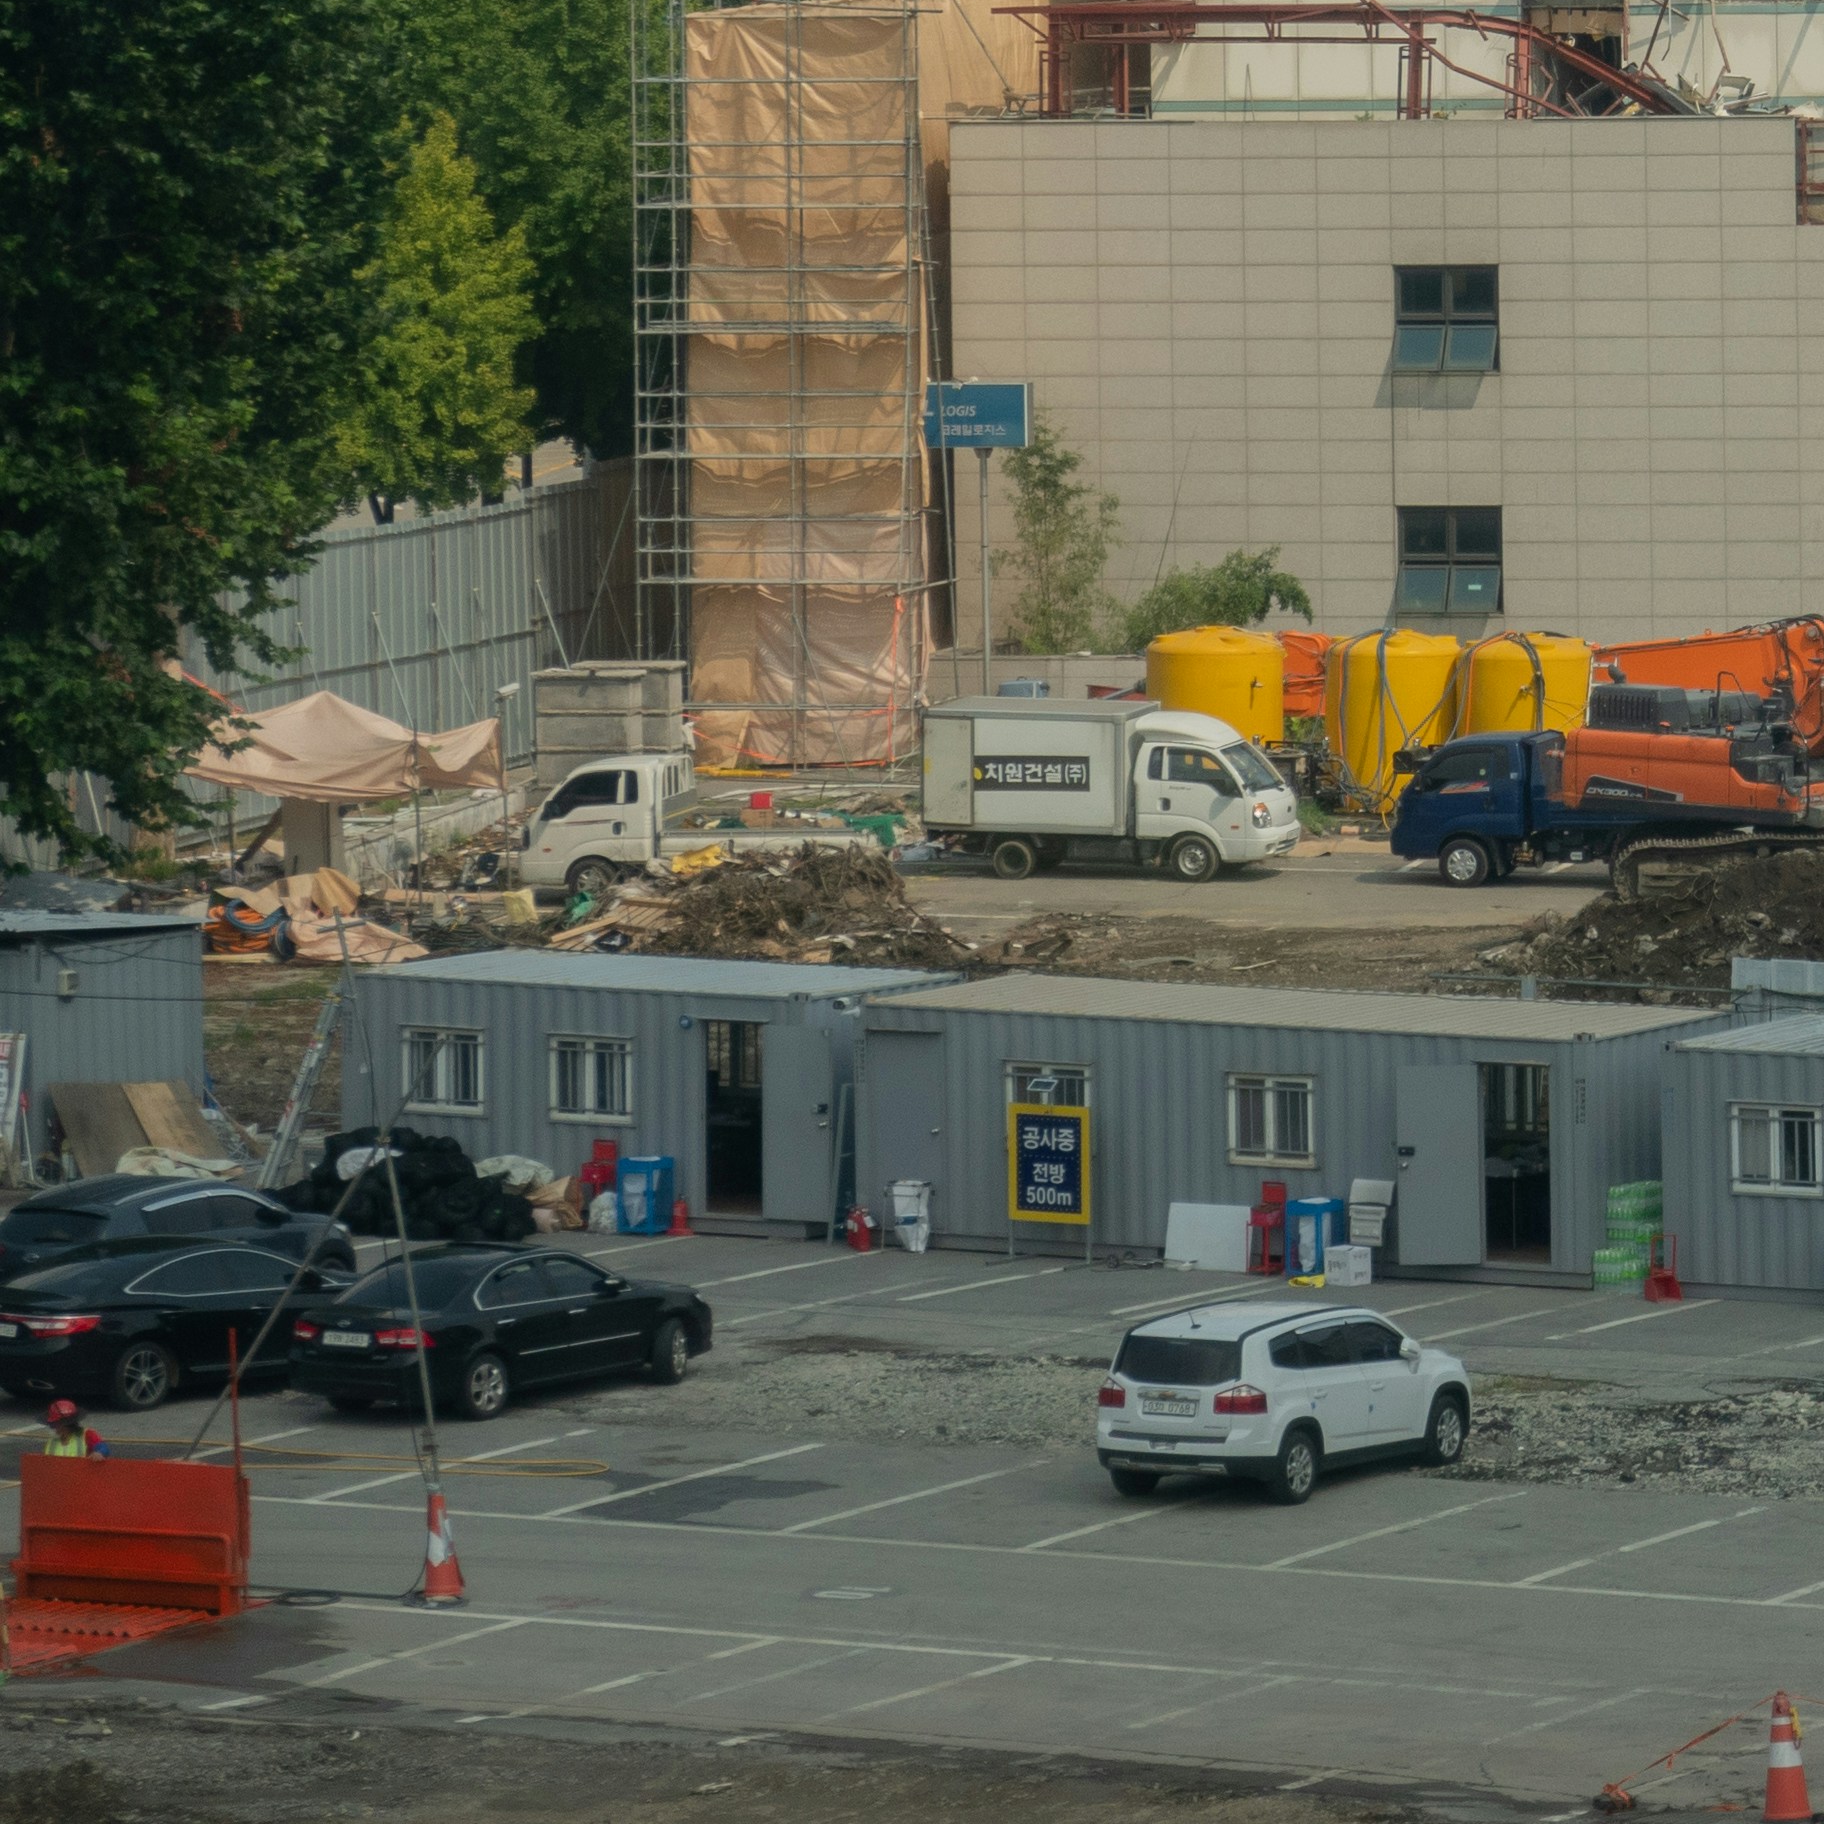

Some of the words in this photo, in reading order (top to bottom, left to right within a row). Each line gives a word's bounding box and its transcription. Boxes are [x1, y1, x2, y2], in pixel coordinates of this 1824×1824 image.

[984, 762, 1087, 785] 치원건설(주)
[1022, 1127, 1076, 1152] 공사중
[1033, 1162, 1066, 1185] 전방
[1026, 1186, 1072, 1206] 500m
